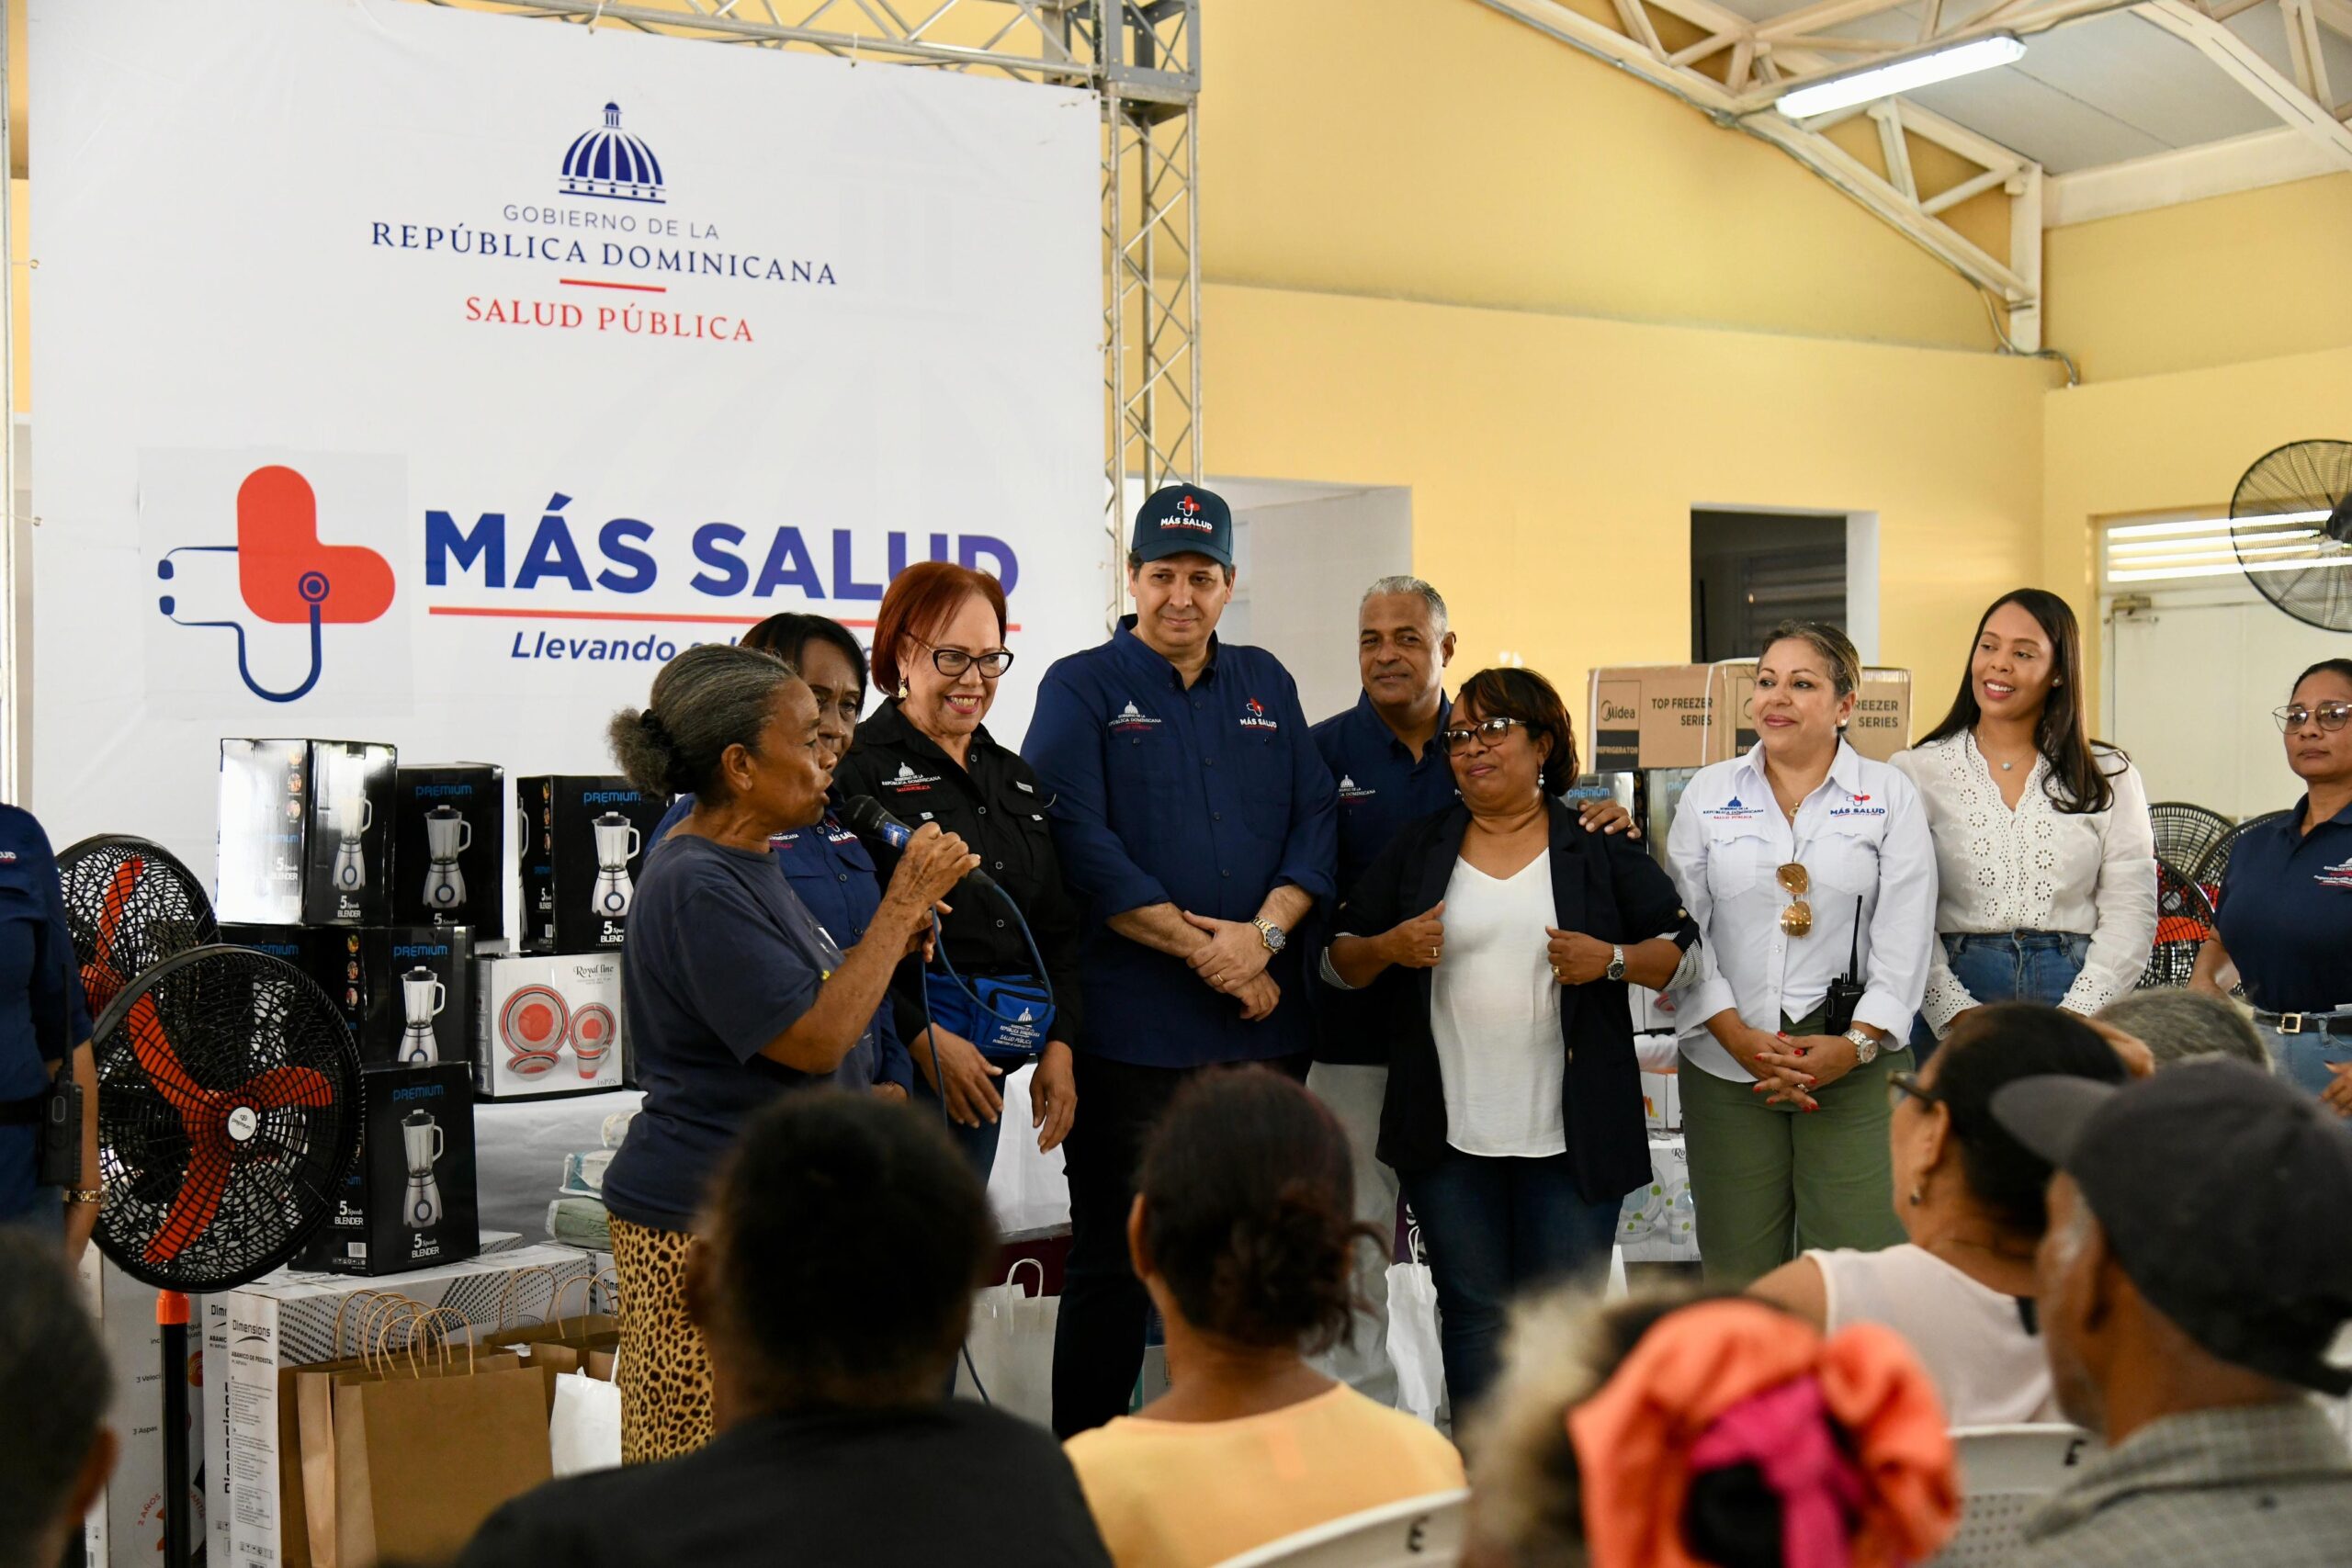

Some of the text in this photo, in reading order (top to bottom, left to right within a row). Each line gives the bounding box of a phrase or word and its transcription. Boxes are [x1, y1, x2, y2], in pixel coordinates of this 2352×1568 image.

[503, 205, 719, 241] GOBIERNO DE LA
[371, 221, 838, 286] REPÚBLICA DOMINICANA
[466, 296, 754, 343] SALUD PÚBLICA
[1160, 515, 1181, 526] MÁS
[1182, 518, 1213, 530] SALUD
[425, 491, 658, 594] MÁS
[511, 630, 676, 661] Llevando
[1652, 697, 1713, 710] TOP FREEZER
[1854, 699, 1899, 711] REEZER
[1602, 702, 1635, 721] Midea
[1239, 716, 1277, 728] MÁS SALUD
[1680, 715, 1713, 727] SERIES
[1859, 716, 1899, 728] SERIES
[277, 857, 285, 871] 5
[272, 872, 299, 882] LENDER
[541, 887, 546, 901] 5
[340, 896, 347, 908] 5
[337, 909, 362, 918] BLENDER
[434, 912, 443, 925] 5
[604, 920, 613, 934] 5
[601, 935, 625, 943] BLEND
[573, 964, 598, 977] Royal
[339, 1200, 347, 1215] 5
[334, 1216, 364, 1225] BLENDER
[413, 1233, 437, 1248] 5 Speeds
[412, 1247, 440, 1258] BLENDER
[232, 1319, 271, 1337] Dimensions
[209, 1336, 227, 1344] ABANIC
[138, 1426, 158, 1435] Aspas
[141, 1493, 162, 1519] AÑOS
